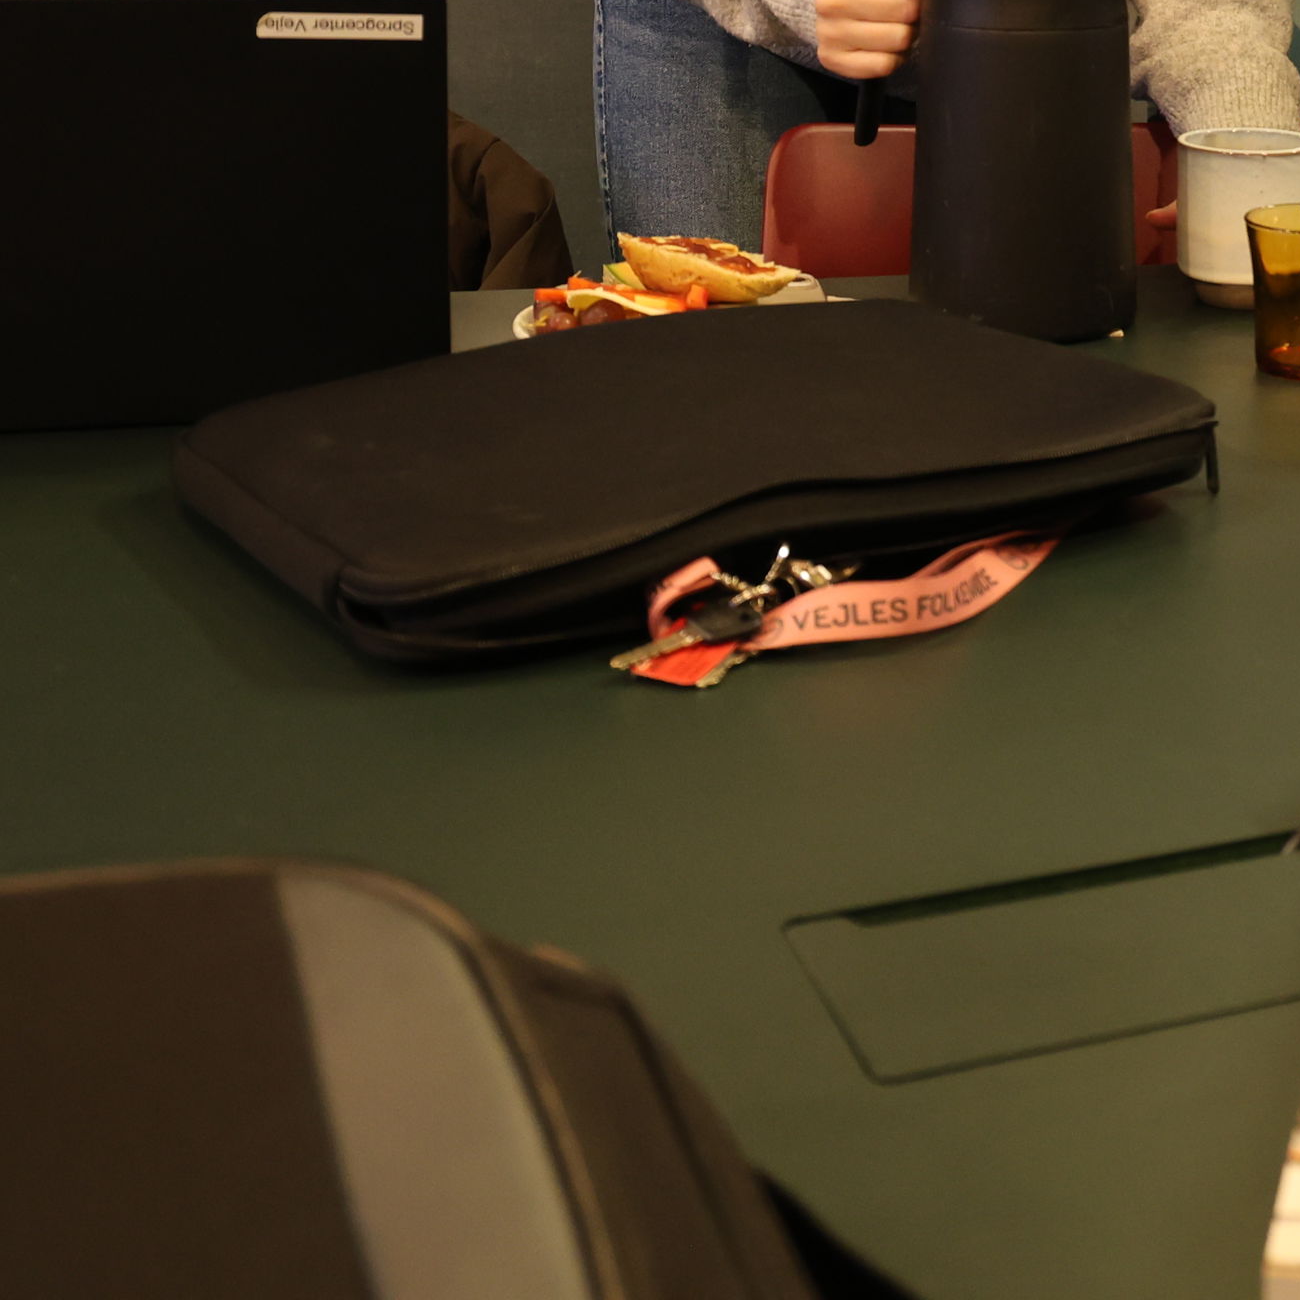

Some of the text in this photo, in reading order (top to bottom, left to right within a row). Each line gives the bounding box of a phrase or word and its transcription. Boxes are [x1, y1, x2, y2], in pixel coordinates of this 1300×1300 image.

[264, 16, 415, 35] Sprogcenter Vejle
[792, 598, 909, 631] VEJLES
